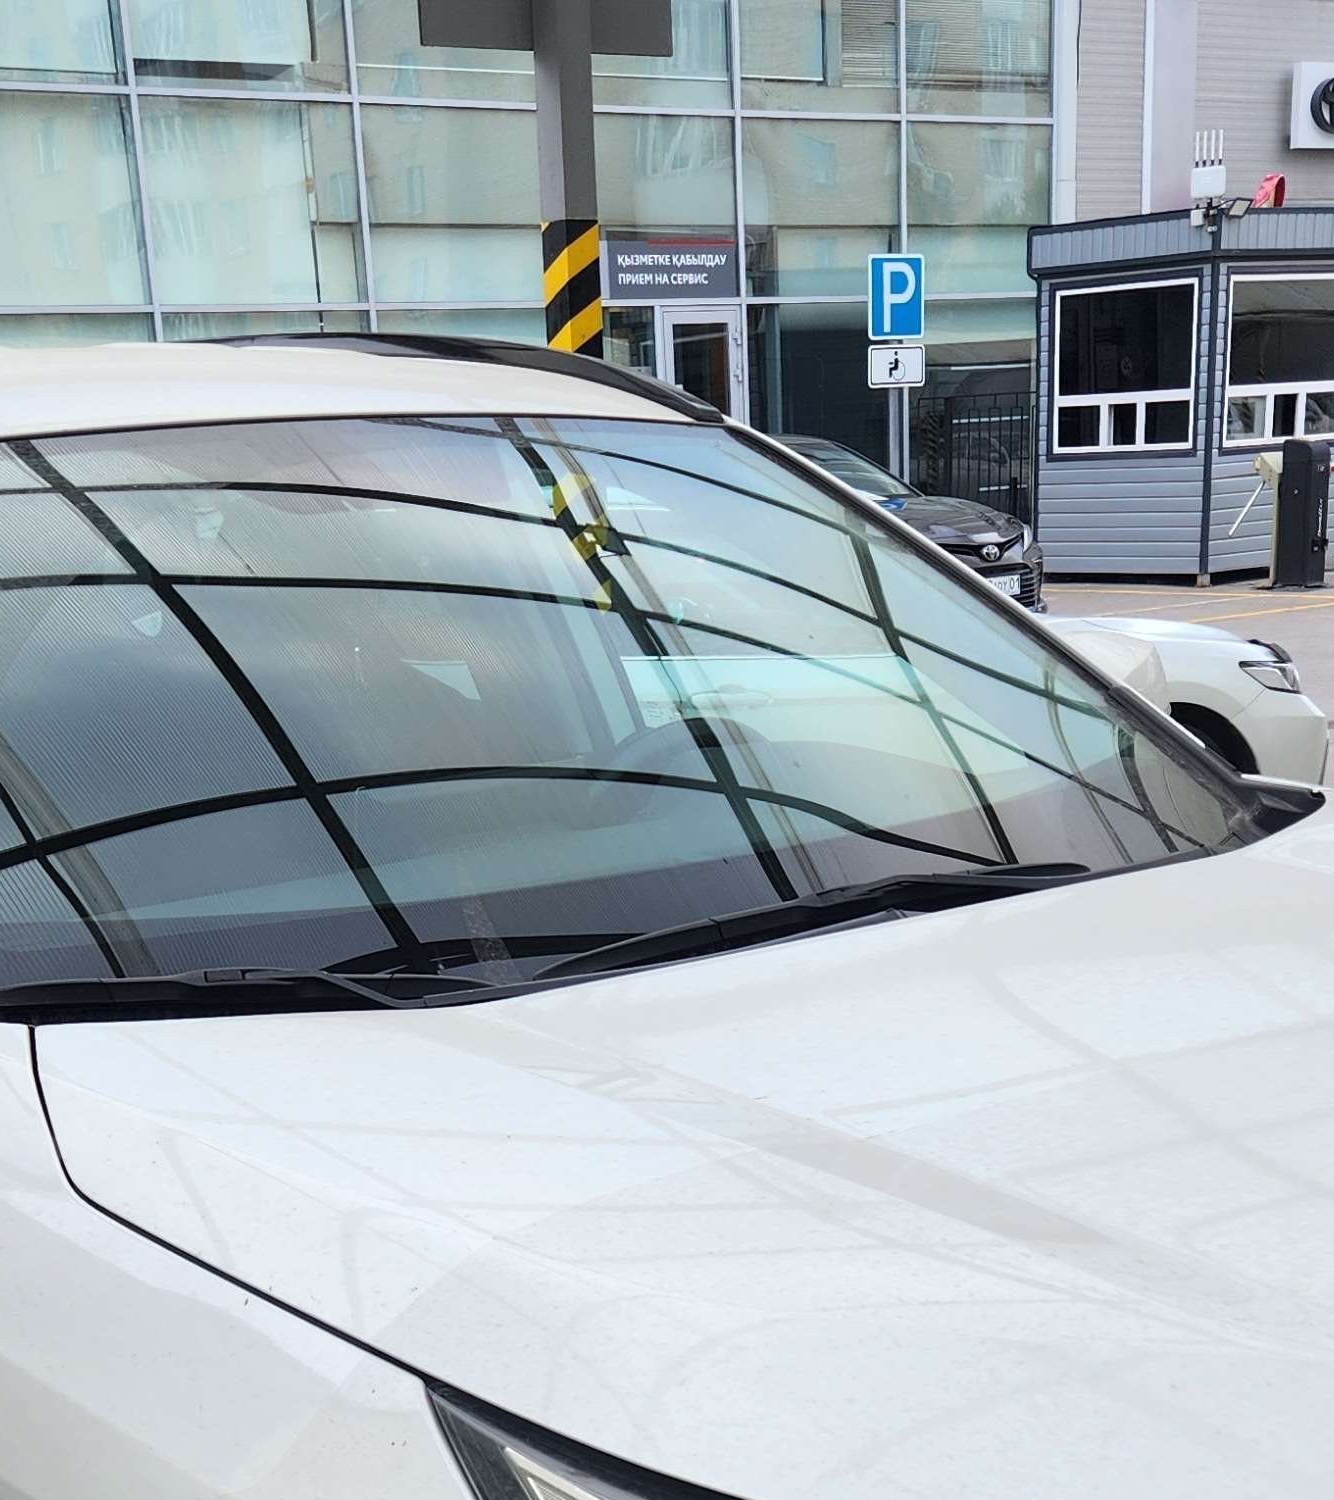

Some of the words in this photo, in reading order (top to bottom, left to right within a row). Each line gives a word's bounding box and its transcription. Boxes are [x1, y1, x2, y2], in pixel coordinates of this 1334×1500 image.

[617, 254, 671, 267] ҚЫЗМЕТКЕ
[672, 254, 727, 267] ҚАБЫЛДАУ
[618, 273, 653, 285] ПРИЕМ
[655, 273, 669, 285] НА
[670, 273, 709, 285] СЕРВИС
[882, 261, 916, 333] P
